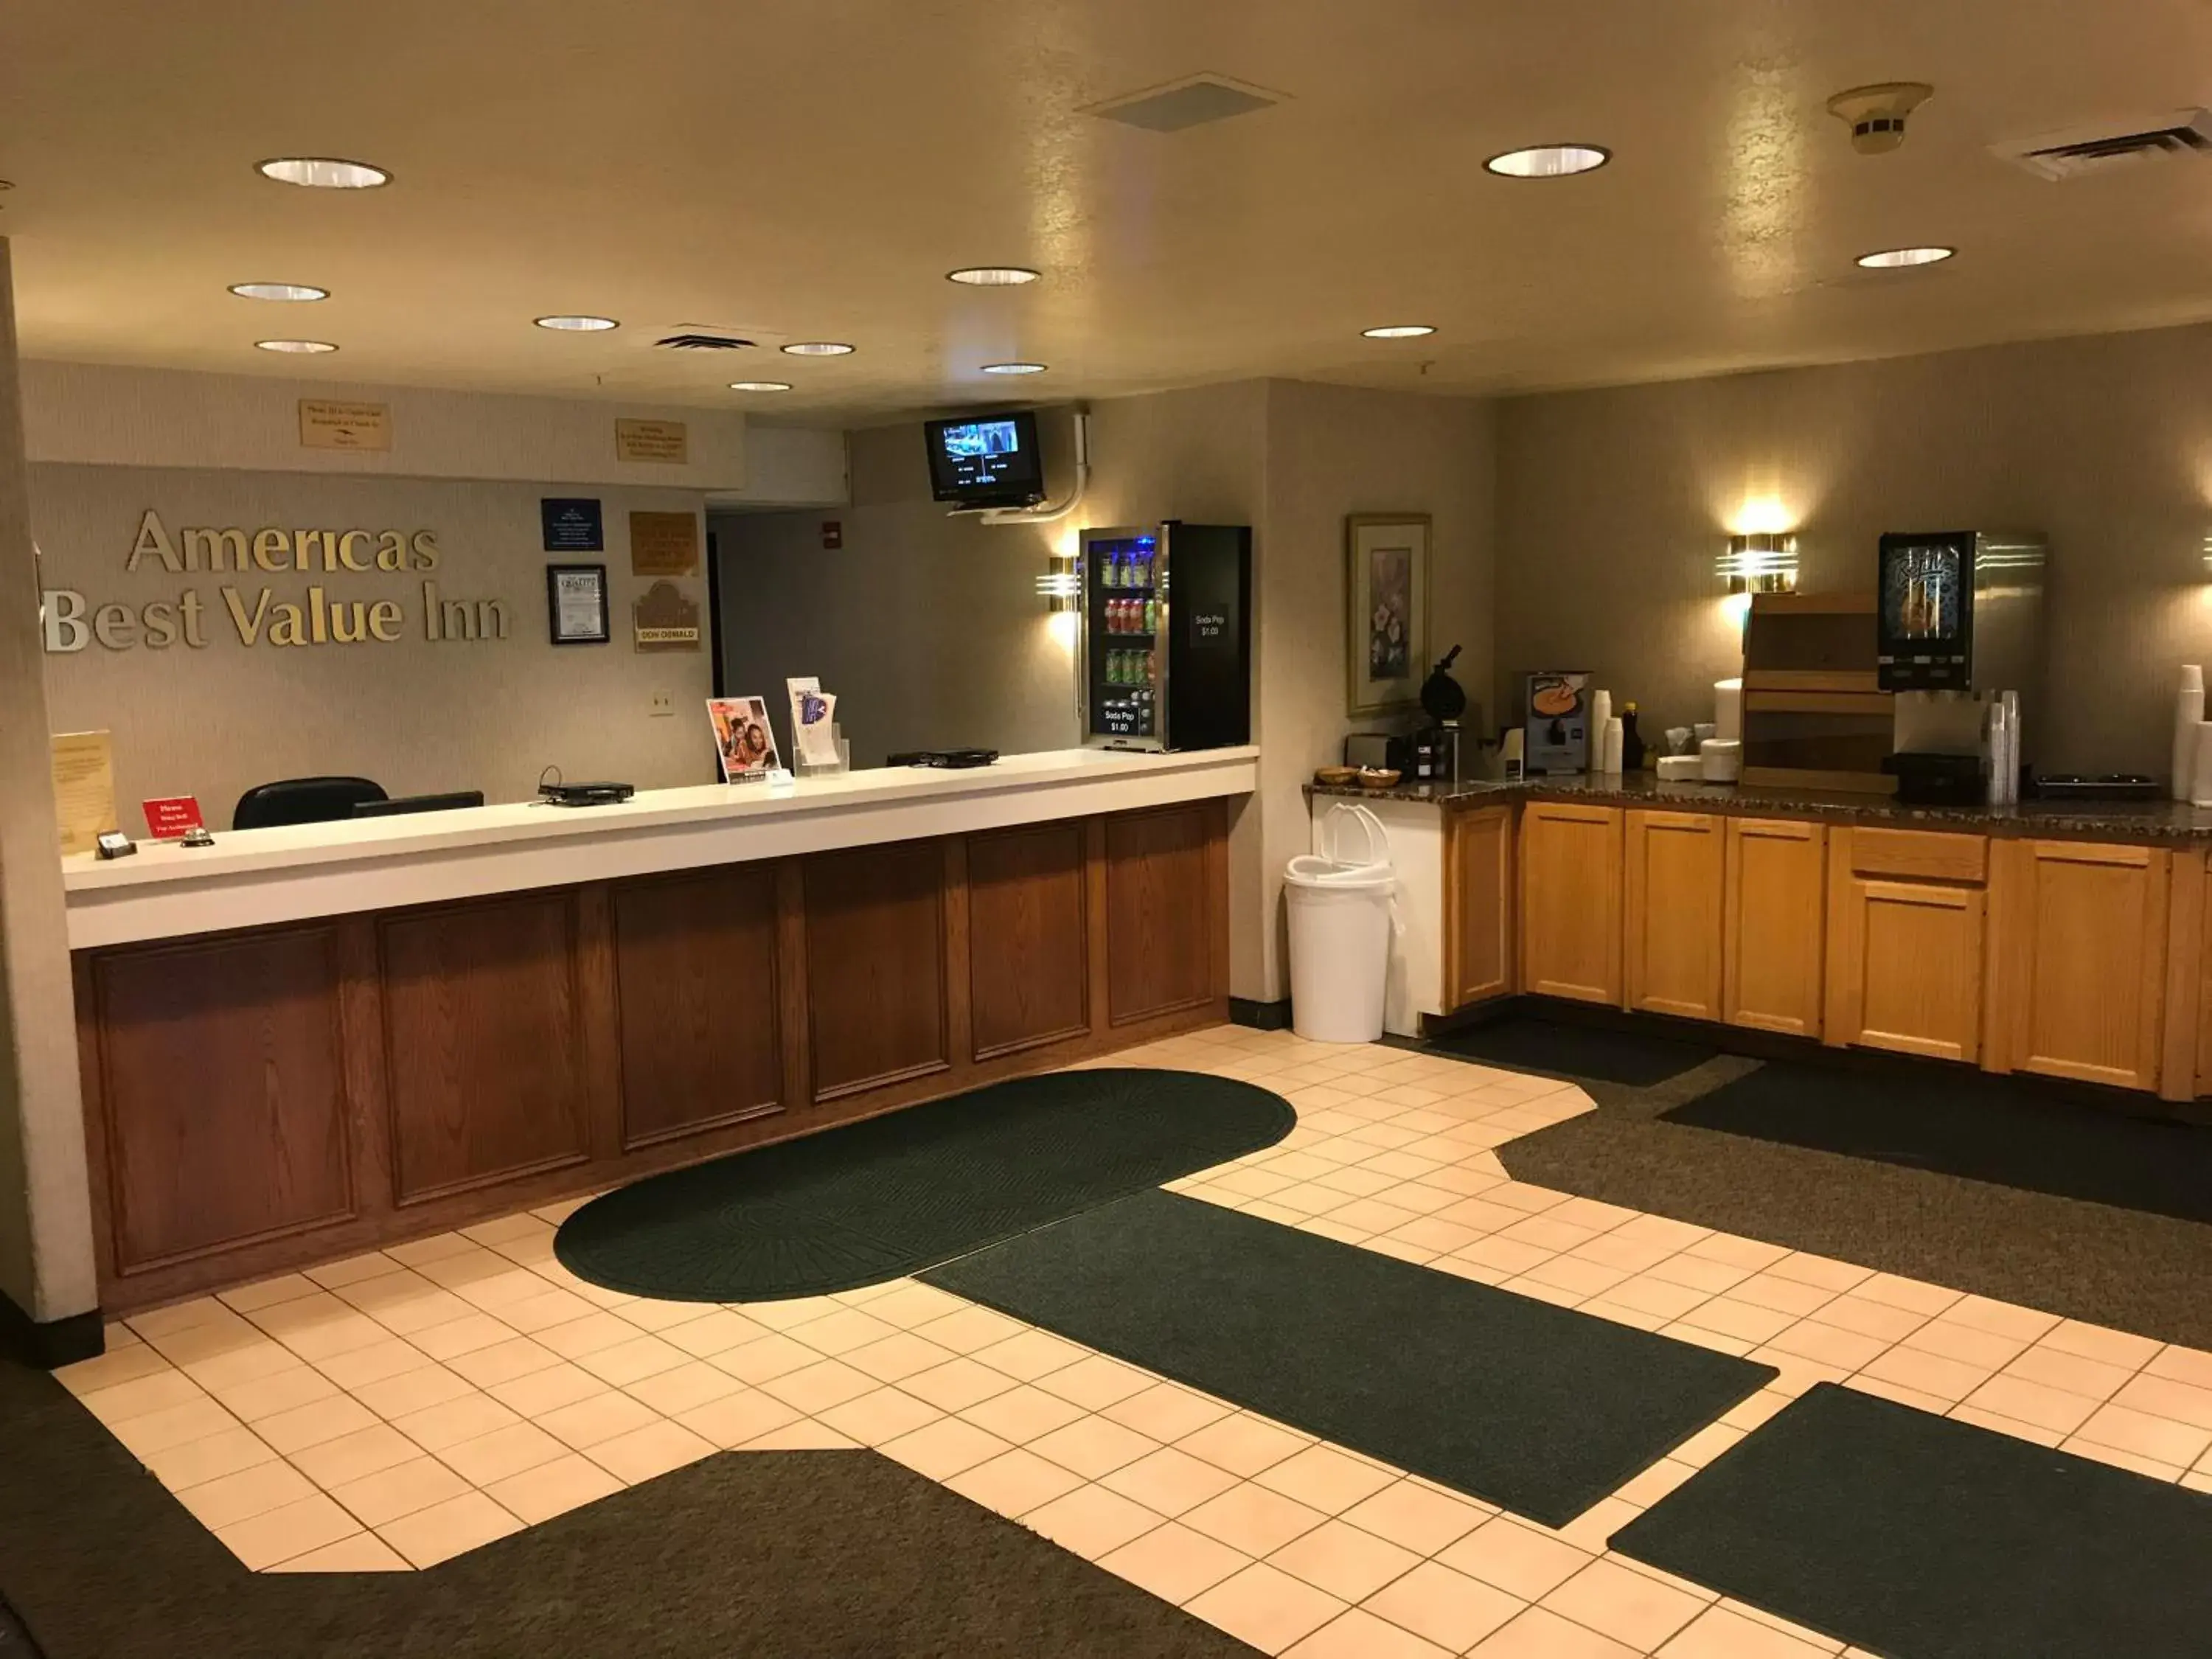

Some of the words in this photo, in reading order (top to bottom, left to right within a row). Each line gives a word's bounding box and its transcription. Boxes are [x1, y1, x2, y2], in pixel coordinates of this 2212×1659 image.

[126, 509, 441, 573] Americas
[44, 587, 207, 653] Best
[223, 585, 404, 647] Value
[424, 581, 510, 641] Inn
[1195, 614, 1211, 625] Soda
[1211, 614, 1225, 625] Pop
[1105, 710, 1121, 720] Soda
[1121, 711, 1135, 722] Pop
[1111, 722, 1129, 732] $1.00
